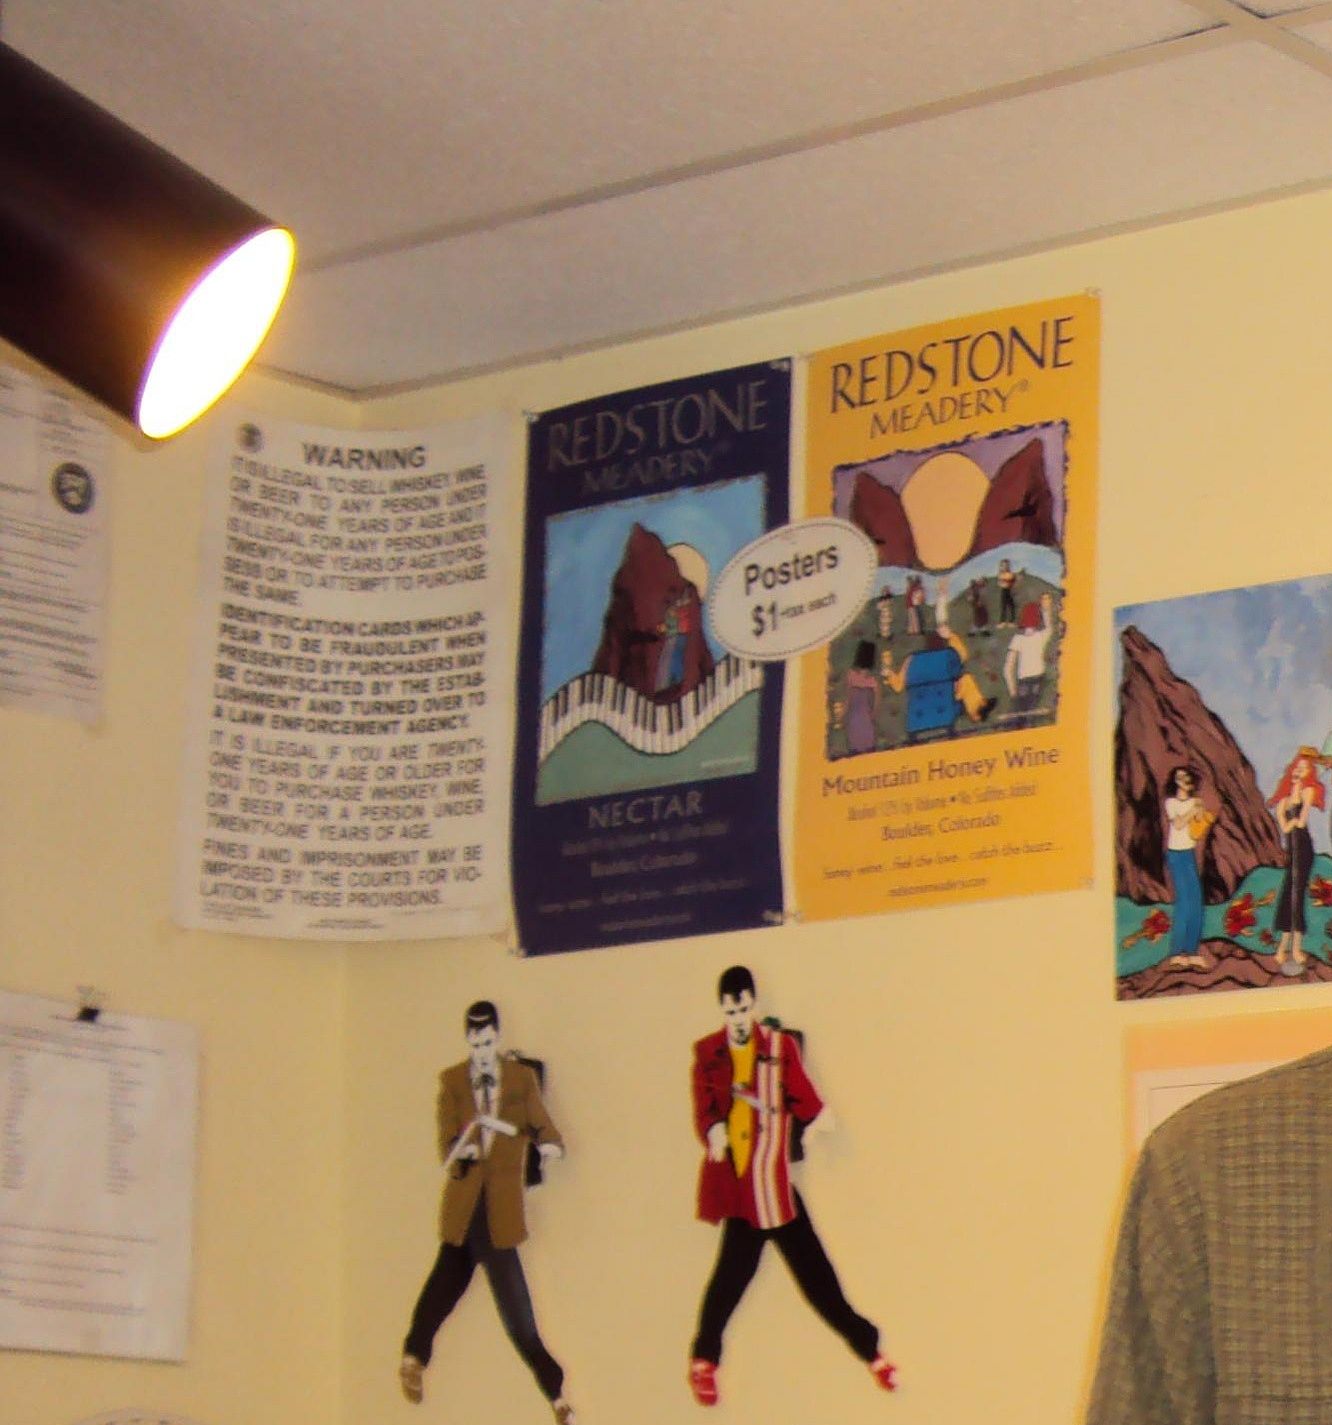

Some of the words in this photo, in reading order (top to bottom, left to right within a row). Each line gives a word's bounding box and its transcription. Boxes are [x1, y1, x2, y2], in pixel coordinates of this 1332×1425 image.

[830, 315, 1076, 414] REDSTONE
[547, 378, 769, 474] REDSTONE
[868, 384, 1014, 440] MEADERY
[302, 443, 427, 470] WARNING
[582, 446, 718, 496] MEADERY
[743, 545, 840, 596] Posters
[821, 765, 921, 797] Mountain
[927, 756, 998, 782] Honey
[1003, 746, 1061, 770] Wine
[587, 791, 702, 831] NECTAR
